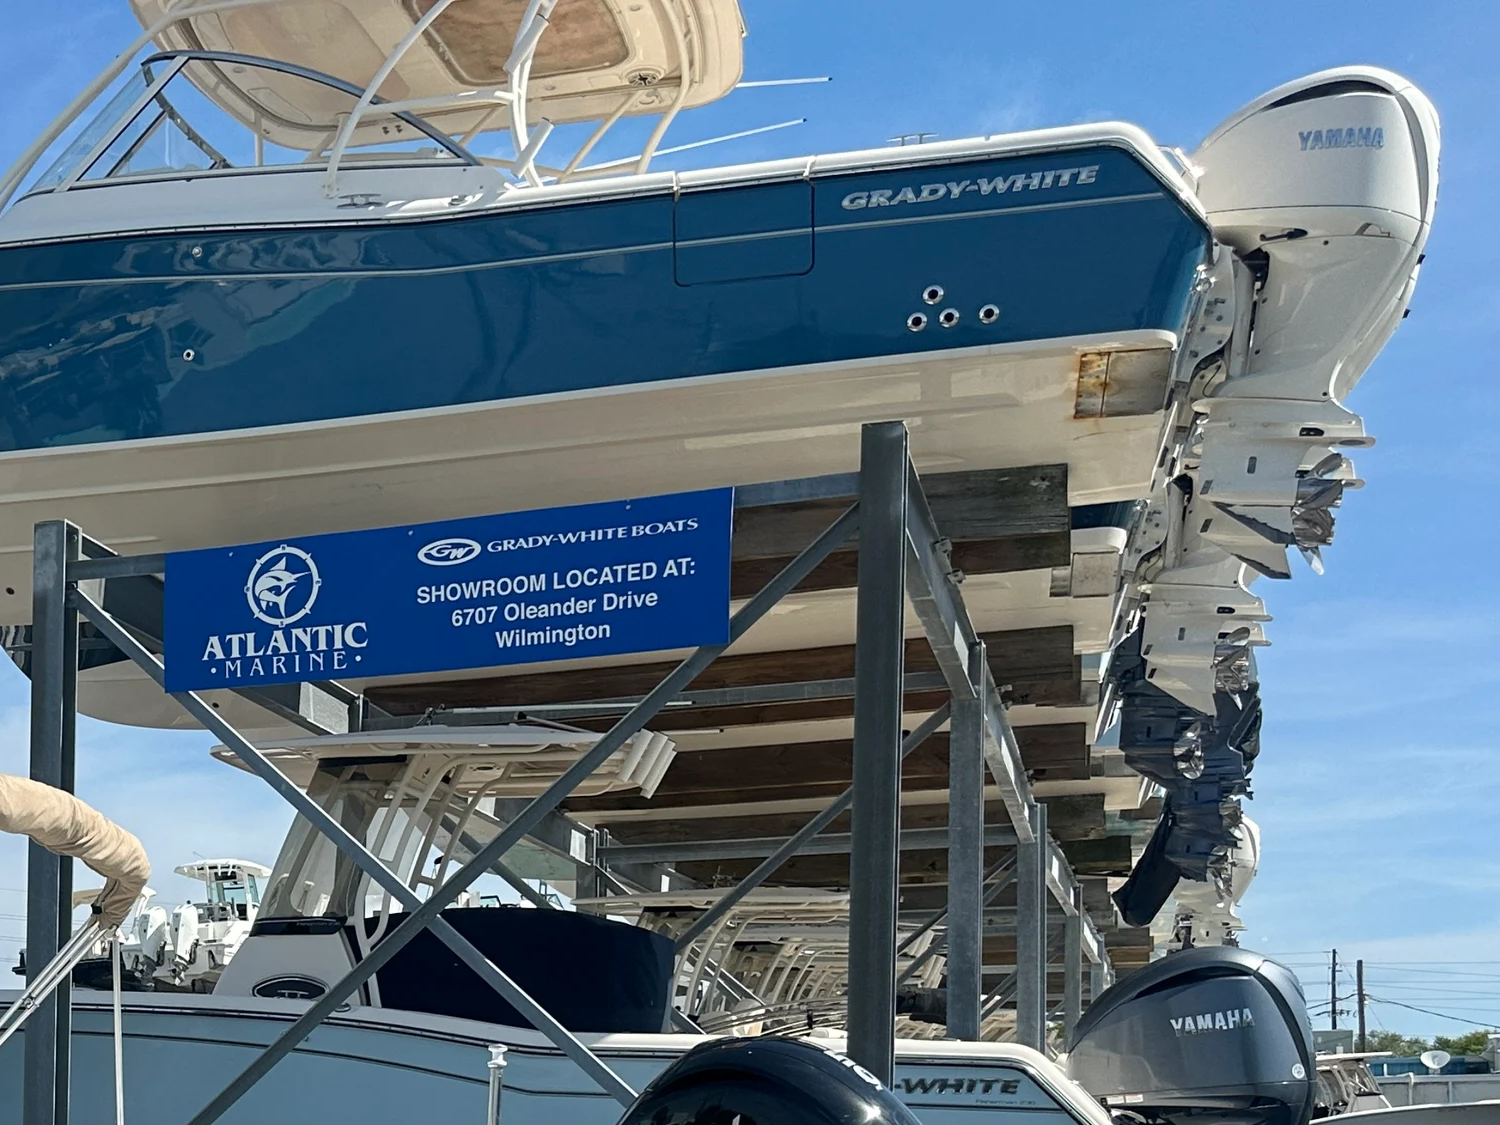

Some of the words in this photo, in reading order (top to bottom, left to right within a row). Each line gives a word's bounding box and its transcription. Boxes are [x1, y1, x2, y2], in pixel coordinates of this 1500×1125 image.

[1298, 126, 1385, 151] YAMAHA
[841, 164, 1100, 211] GRADY-WHITE
[486, 525, 628, 553] GRADY-WHITE
[631, 517, 699, 538] BOATS
[416, 573, 546, 604] SHOWROOM
[553, 560, 657, 590] LOCATED
[663, 557, 696, 578] AT:
[451, 606, 498, 627] 6707
[504, 597, 597, 622] Oleander
[603, 590, 658, 611] Drive
[202, 621, 368, 661] ATLANTIC
[495, 623, 611, 648] Wilmington
[224, 651, 348, 679] MARINE
[1169, 1007, 1255, 1037] YAMAHA
[894, 1077, 1020, 1095] -WHITE
